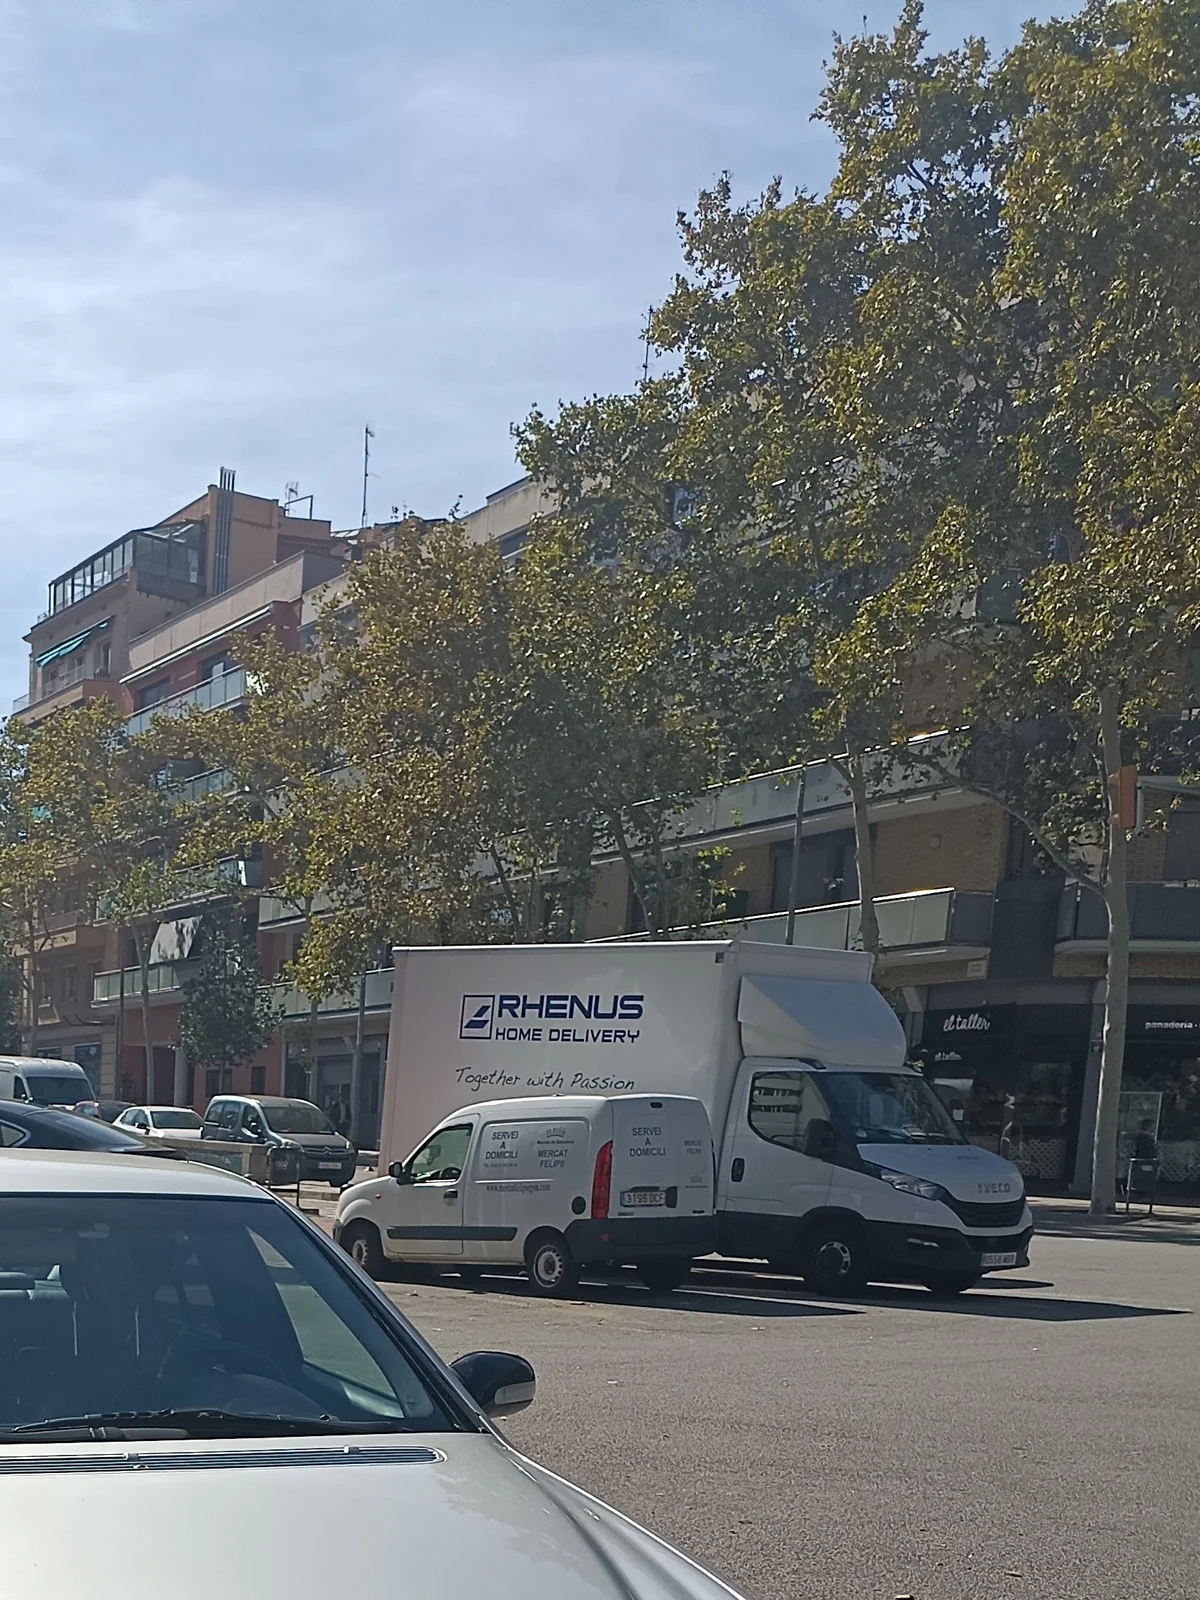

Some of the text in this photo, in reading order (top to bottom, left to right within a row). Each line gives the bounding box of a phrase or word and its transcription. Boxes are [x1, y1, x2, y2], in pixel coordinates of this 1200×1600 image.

[497, 994, 645, 1020] RHENUS
[943, 1014, 955, 1031] el
[495, 1028, 640, 1043] HOME DELIVERY
[455, 1066, 635, 1092] Together with Passion
[492, 1130, 519, 1140] SERVEI
[632, 1126, 661, 1136] SERVEI
[500, 1141, 506, 1149] A
[645, 1137, 651, 1146] A
[485, 1150, 518, 1160] DOMICILI
[538, 1149, 568, 1158] MERCAT
[629, 1147, 666, 1157] DOMICILI
[977, 1182, 1011, 1193] IVECO
